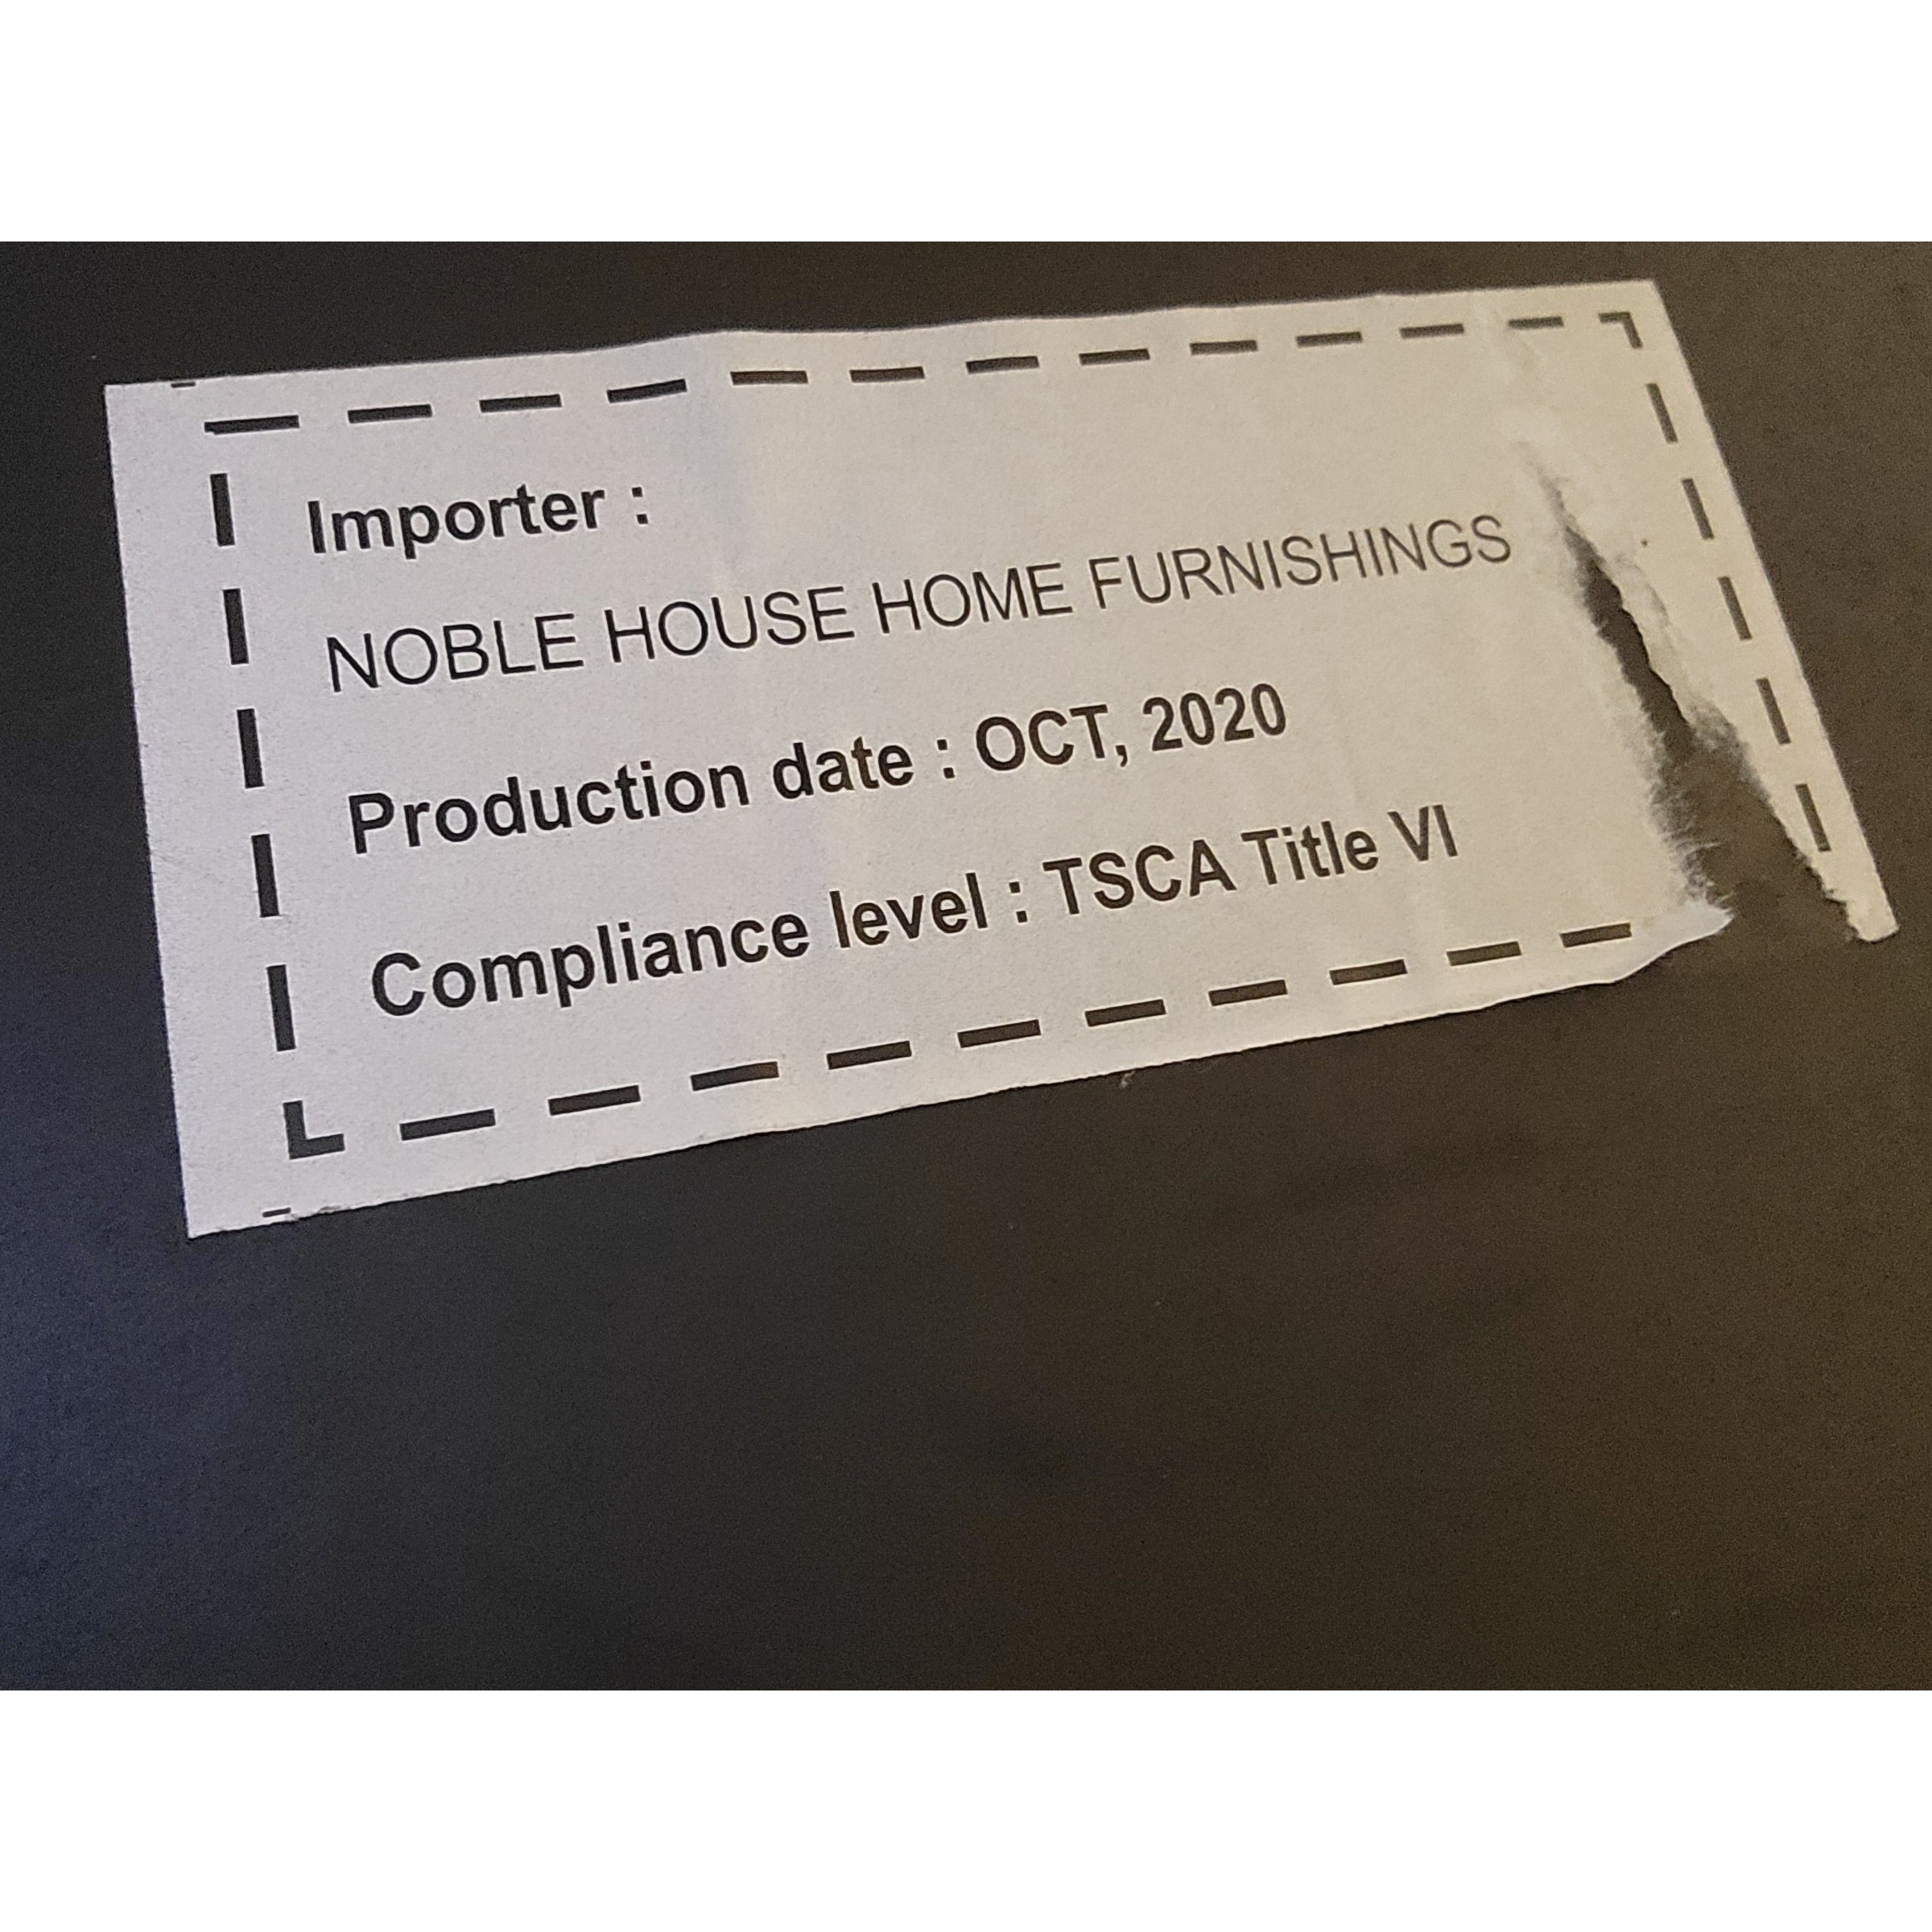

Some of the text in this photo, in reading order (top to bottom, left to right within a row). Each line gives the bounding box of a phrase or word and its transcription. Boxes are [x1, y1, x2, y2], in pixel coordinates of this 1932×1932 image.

[308, 484, 605, 560] Importer
[326, 514, 1511, 693] NOBLE HOUSE HOME FURNISHINGS
[348, 760, 749, 855] Production
[772, 736, 914, 799] date
[976, 704, 1128, 771] OCT,
[1142, 683, 1286, 752] 2020
[371, 914, 810, 1017] Compliance
[829, 872, 988, 948] level
[1042, 839, 1237, 915] TSCA
[1240, 820, 1379, 886] Title
[1387, 804, 1458, 861] VI
